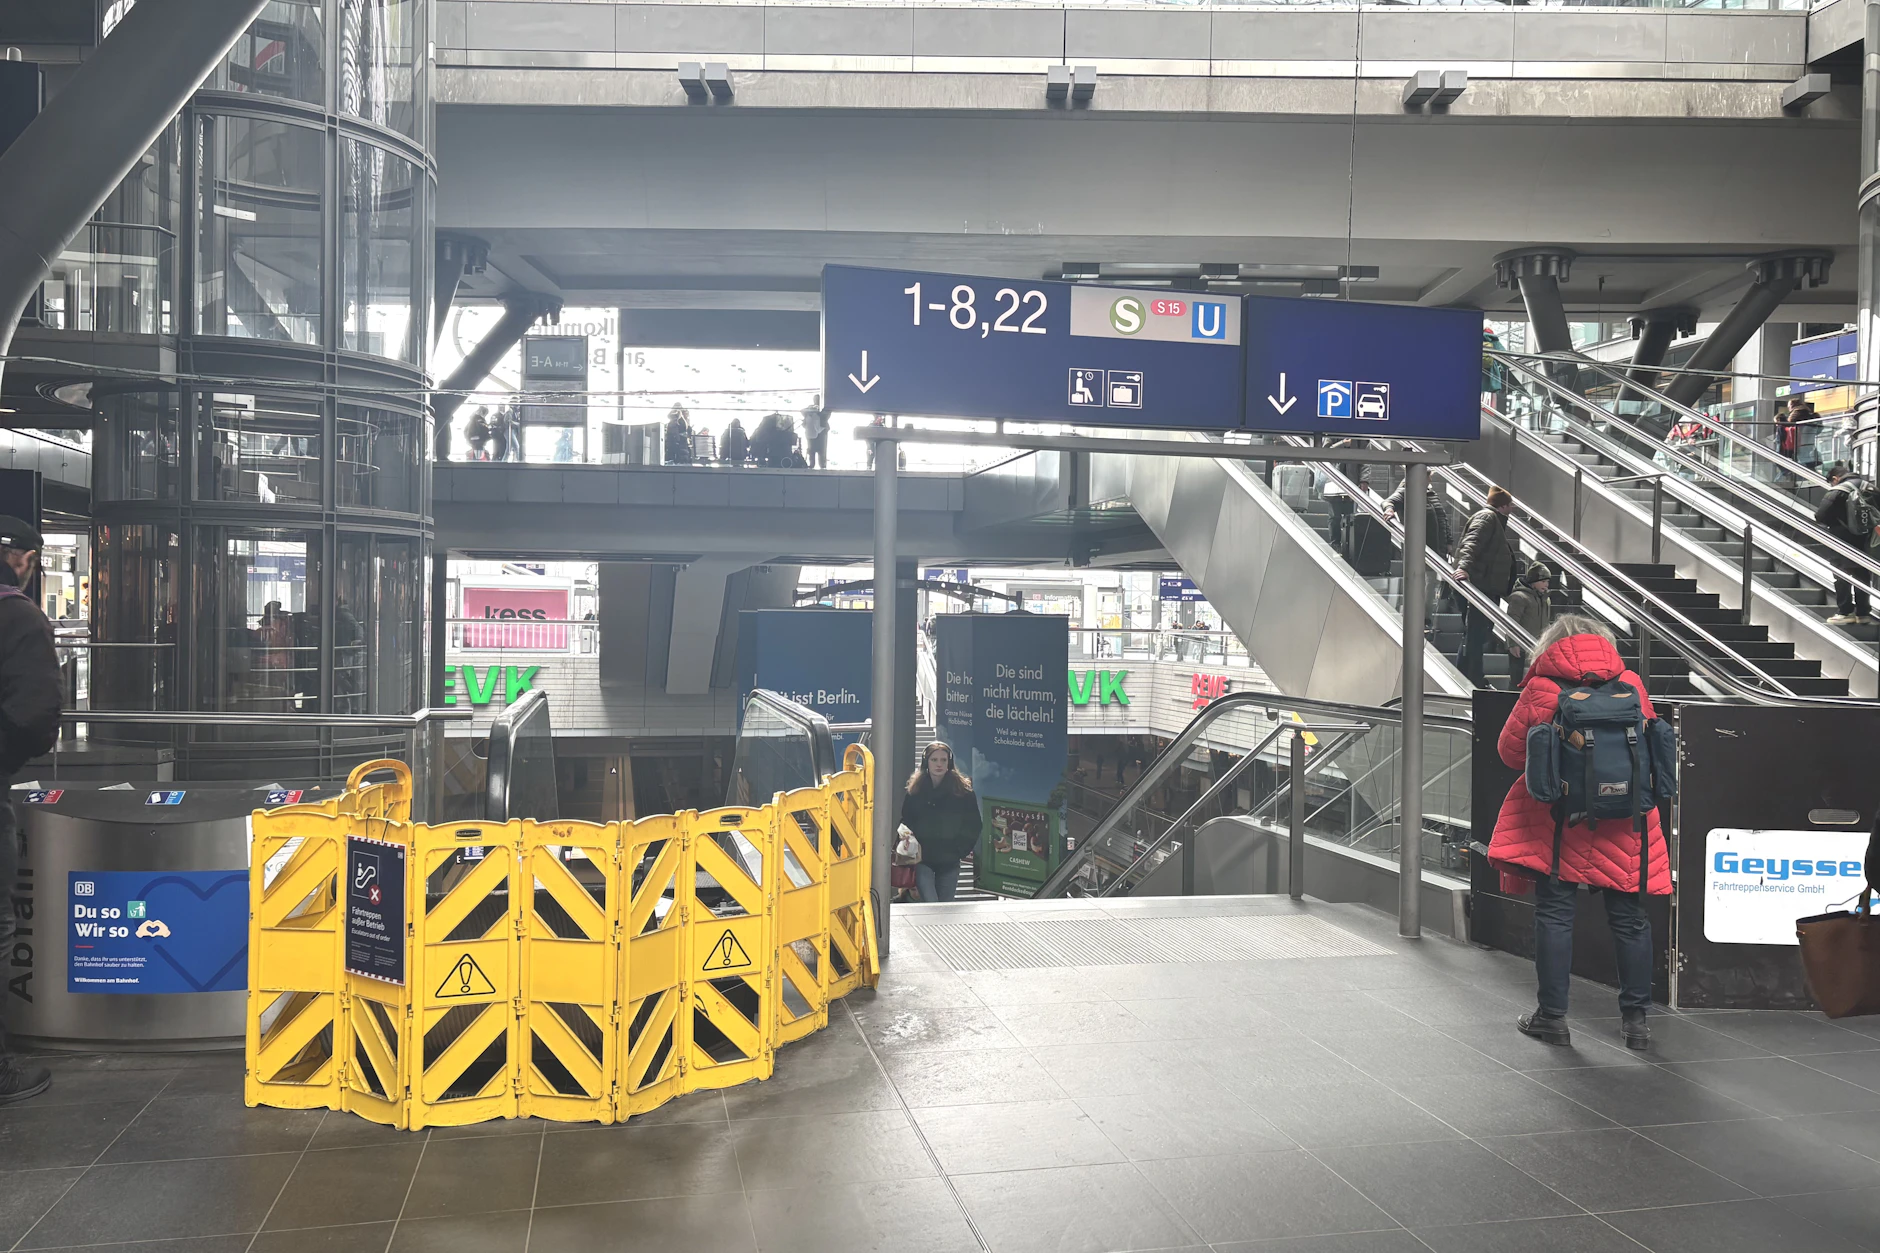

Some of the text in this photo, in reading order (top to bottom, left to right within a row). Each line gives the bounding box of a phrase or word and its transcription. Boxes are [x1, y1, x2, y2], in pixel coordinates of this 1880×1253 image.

[904, 282, 1048, 339] 1-8,22
[1114, 298, 1141, 333] S
[1157, 301, 1180, 315] S 15
[1198, 304, 1220, 337] U
[485, 606, 547, 625] kess
[946, 671, 961, 685] Die
[996, 663, 1043, 680] Die sind
[444, 665, 541, 704] EVK
[1068, 670, 1130, 704] VK
[1191, 673, 1229, 698] REWE
[817, 687, 860, 704] Berlin.
[946, 688, 969, 703] bitter
[983, 683, 1057, 704] nicht krumm,
[985, 703, 1054, 723] die lächeln!
[948, 717, 972, 726] Halbbitter-S
[996, 727, 1008, 735] Weil
[993, 736, 1046, 748] Schokolade dürfen.
[995, 809, 1045, 821] NUSSKLASSE
[1009, 857, 1030, 866] CASHEW
[1714, 851, 1862, 881] Geysse
[76, 883, 93, 895] DB
[1713, 881, 1825, 894] Fahrtreppenservice GmbH
[74, 904, 121, 919] Du so
[351, 906, 382, 921] Fahrtreppen
[75, 923, 129, 938] Wir so
[351, 917, 386, 931] außer Betrieb
[351, 927, 369, 938] Escalators
